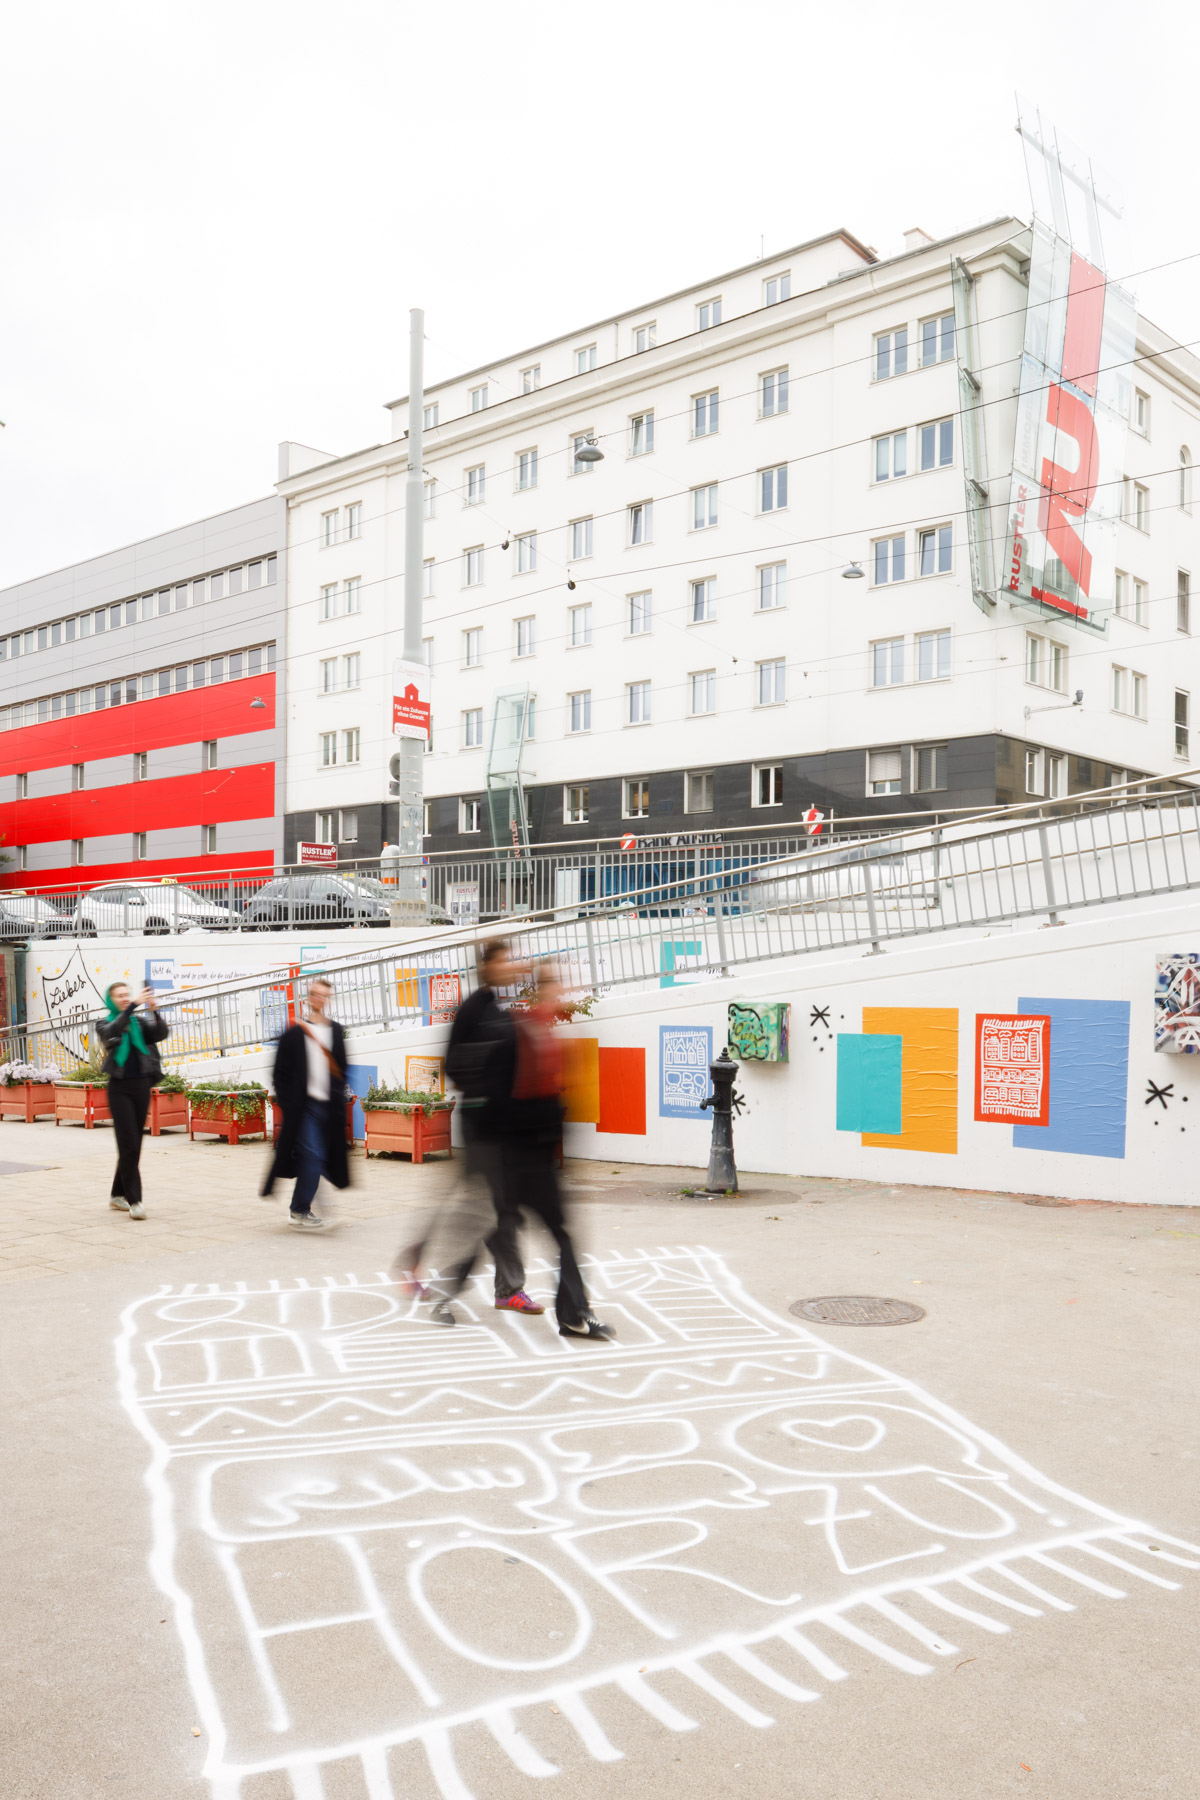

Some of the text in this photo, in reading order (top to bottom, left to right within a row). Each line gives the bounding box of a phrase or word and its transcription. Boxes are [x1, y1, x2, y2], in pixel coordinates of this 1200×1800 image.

[1009, 484, 1028, 591] RUSTLER
[302, 846, 332, 856] RUSTLER
[50, 974, 87, 1009] Liebes
[212, 1477, 1072, 1732] HÖR ZU!
